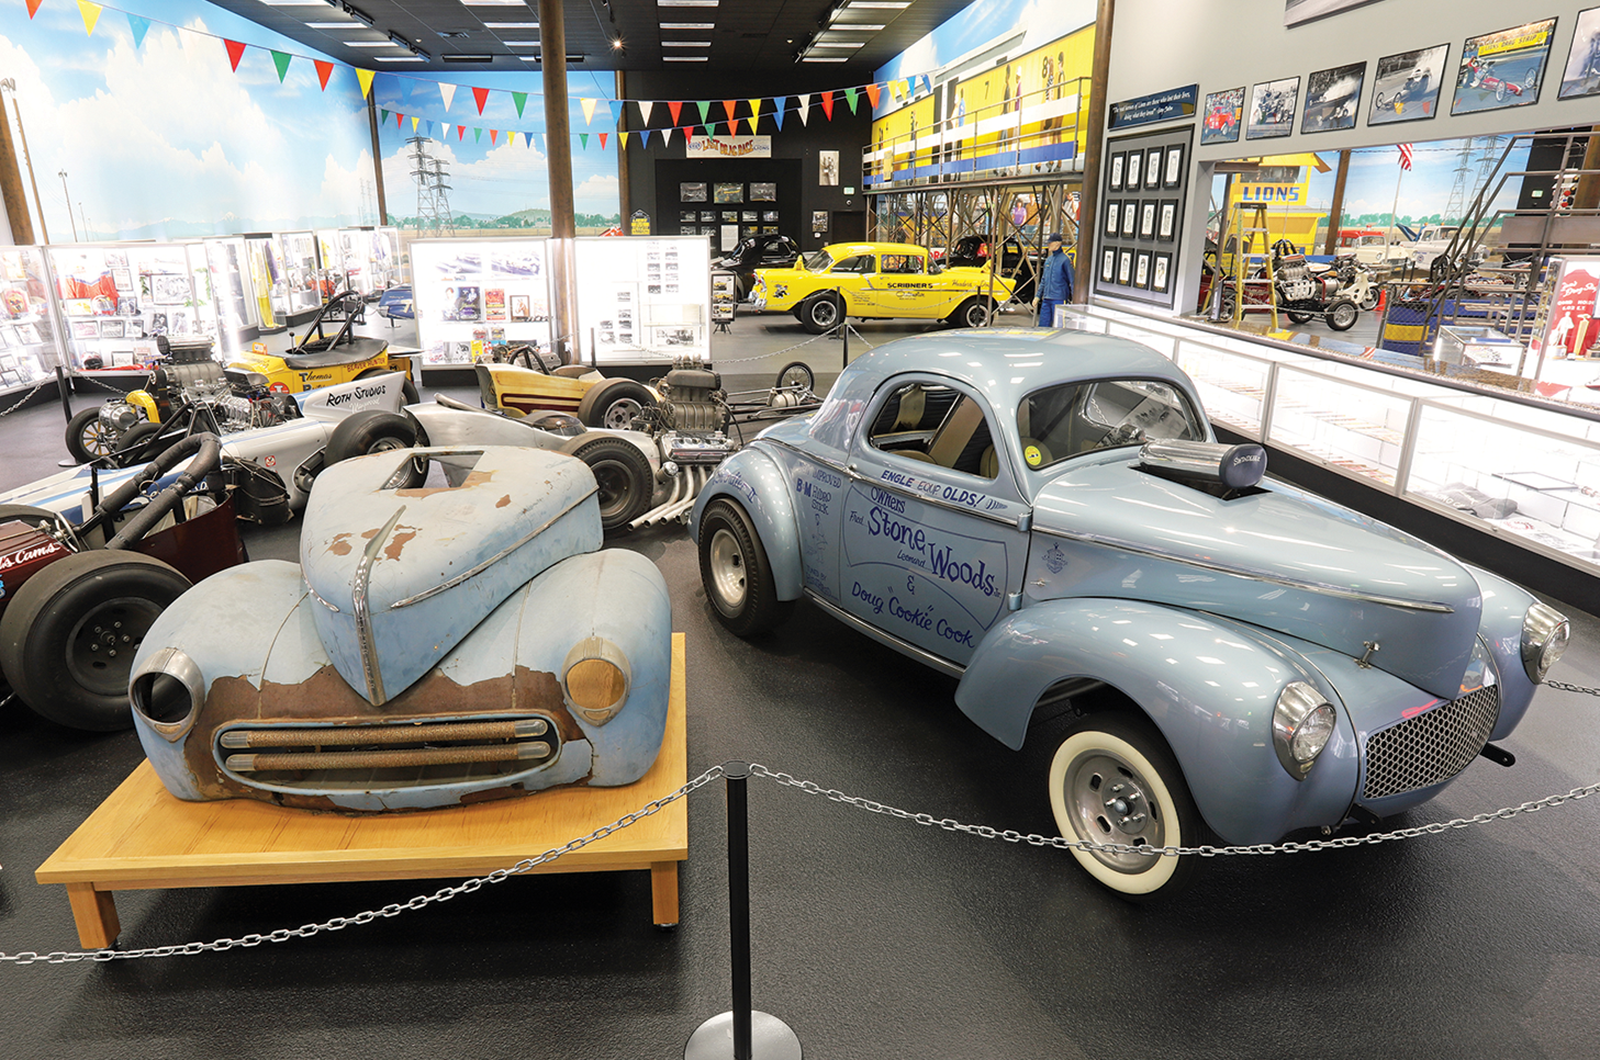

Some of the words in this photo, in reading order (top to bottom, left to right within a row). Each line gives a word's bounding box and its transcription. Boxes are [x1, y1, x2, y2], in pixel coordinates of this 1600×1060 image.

[1242, 186, 1300, 202] LIONS
[299, 370, 333, 384] Thomas
[880, 469, 915, 488] ENGLE
[942, 486, 986, 508] OLDS!
[867, 505, 927, 556] Stone
[15, 542, 62, 565] Cams
[906, 575, 915, 595] &
[927, 542, 996, 597] Woods
[851, 581, 885, 615] Doug
[936, 618, 976, 649] Cook
